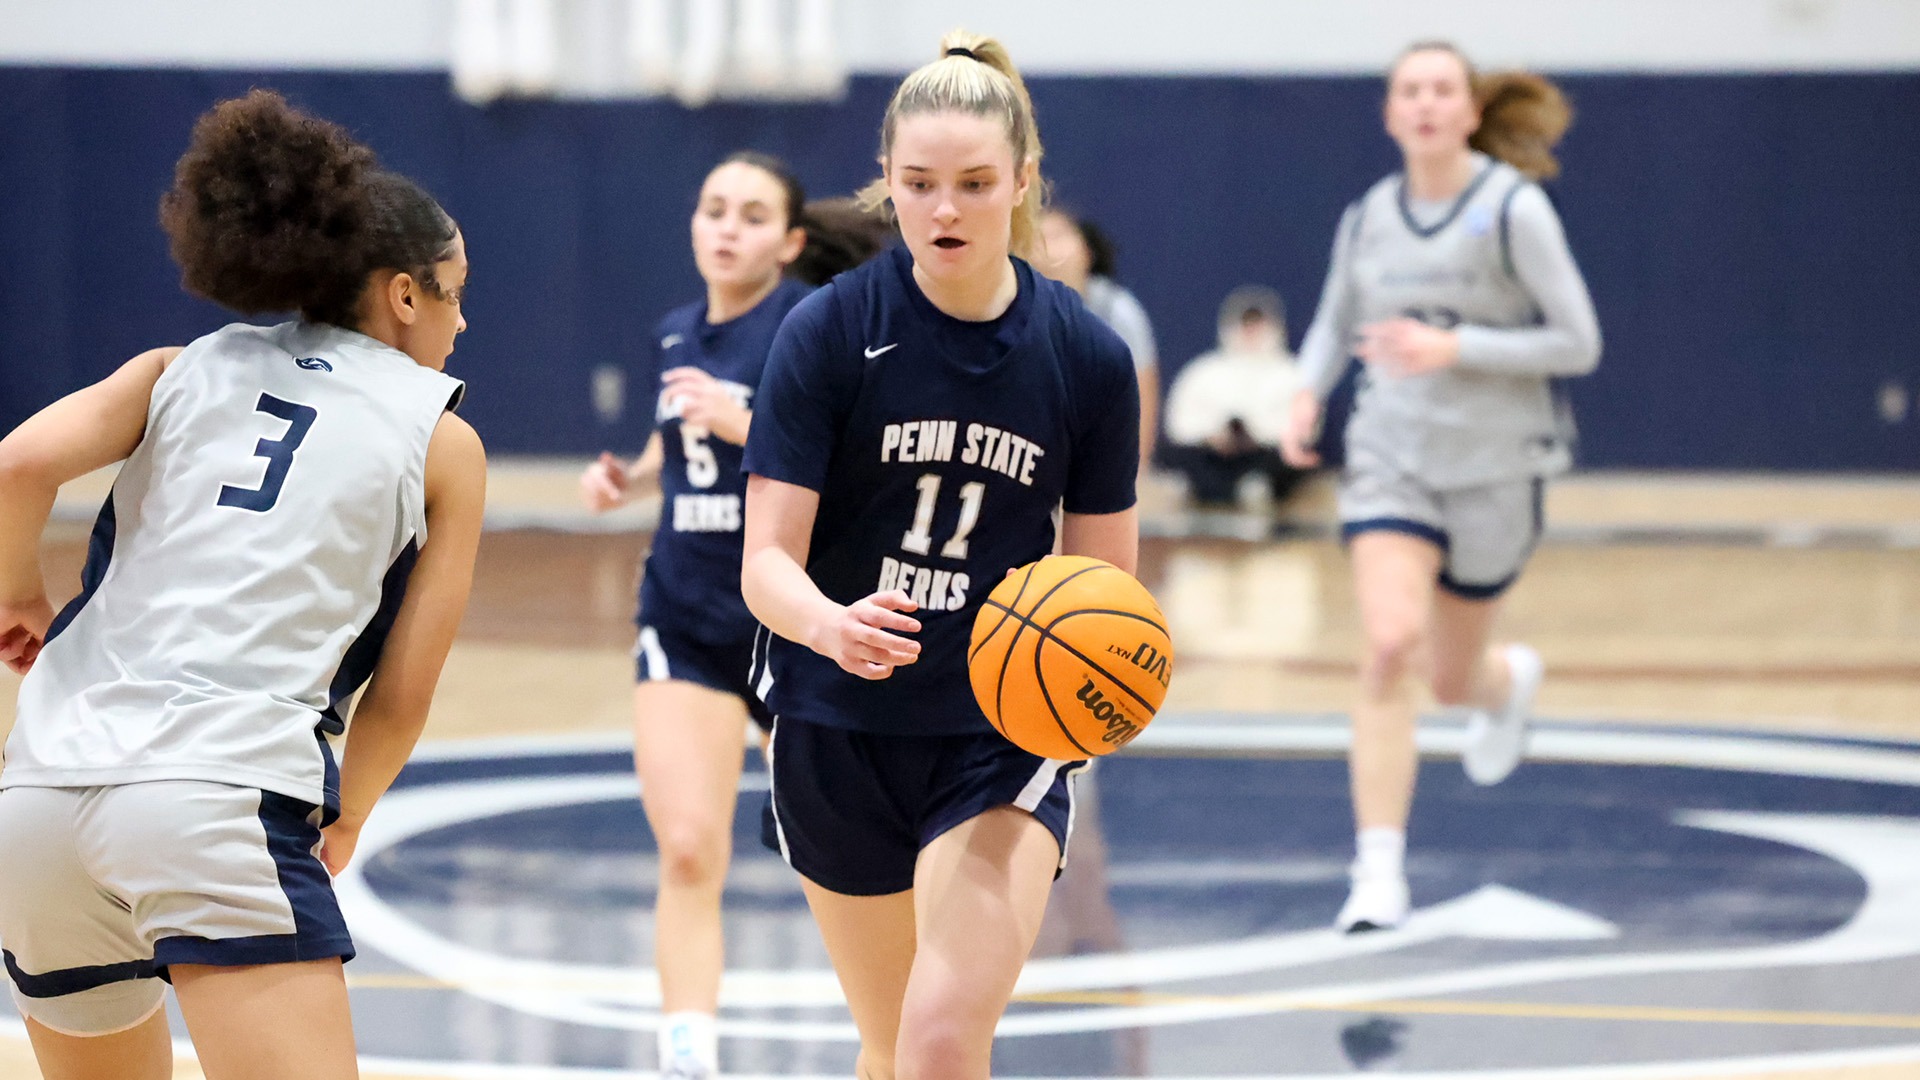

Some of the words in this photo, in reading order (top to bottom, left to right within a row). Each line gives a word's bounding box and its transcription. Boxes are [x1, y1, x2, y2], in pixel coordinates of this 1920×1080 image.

[214, 389, 321, 516] 3
[680, 423, 719, 488] 5
[881, 420, 957, 463] PENN
[961, 423, 1045, 486] STATE
[900, 473, 986, 560] 11
[877, 556, 970, 612] BERKS
[1105, 645, 1132, 660] NXT
